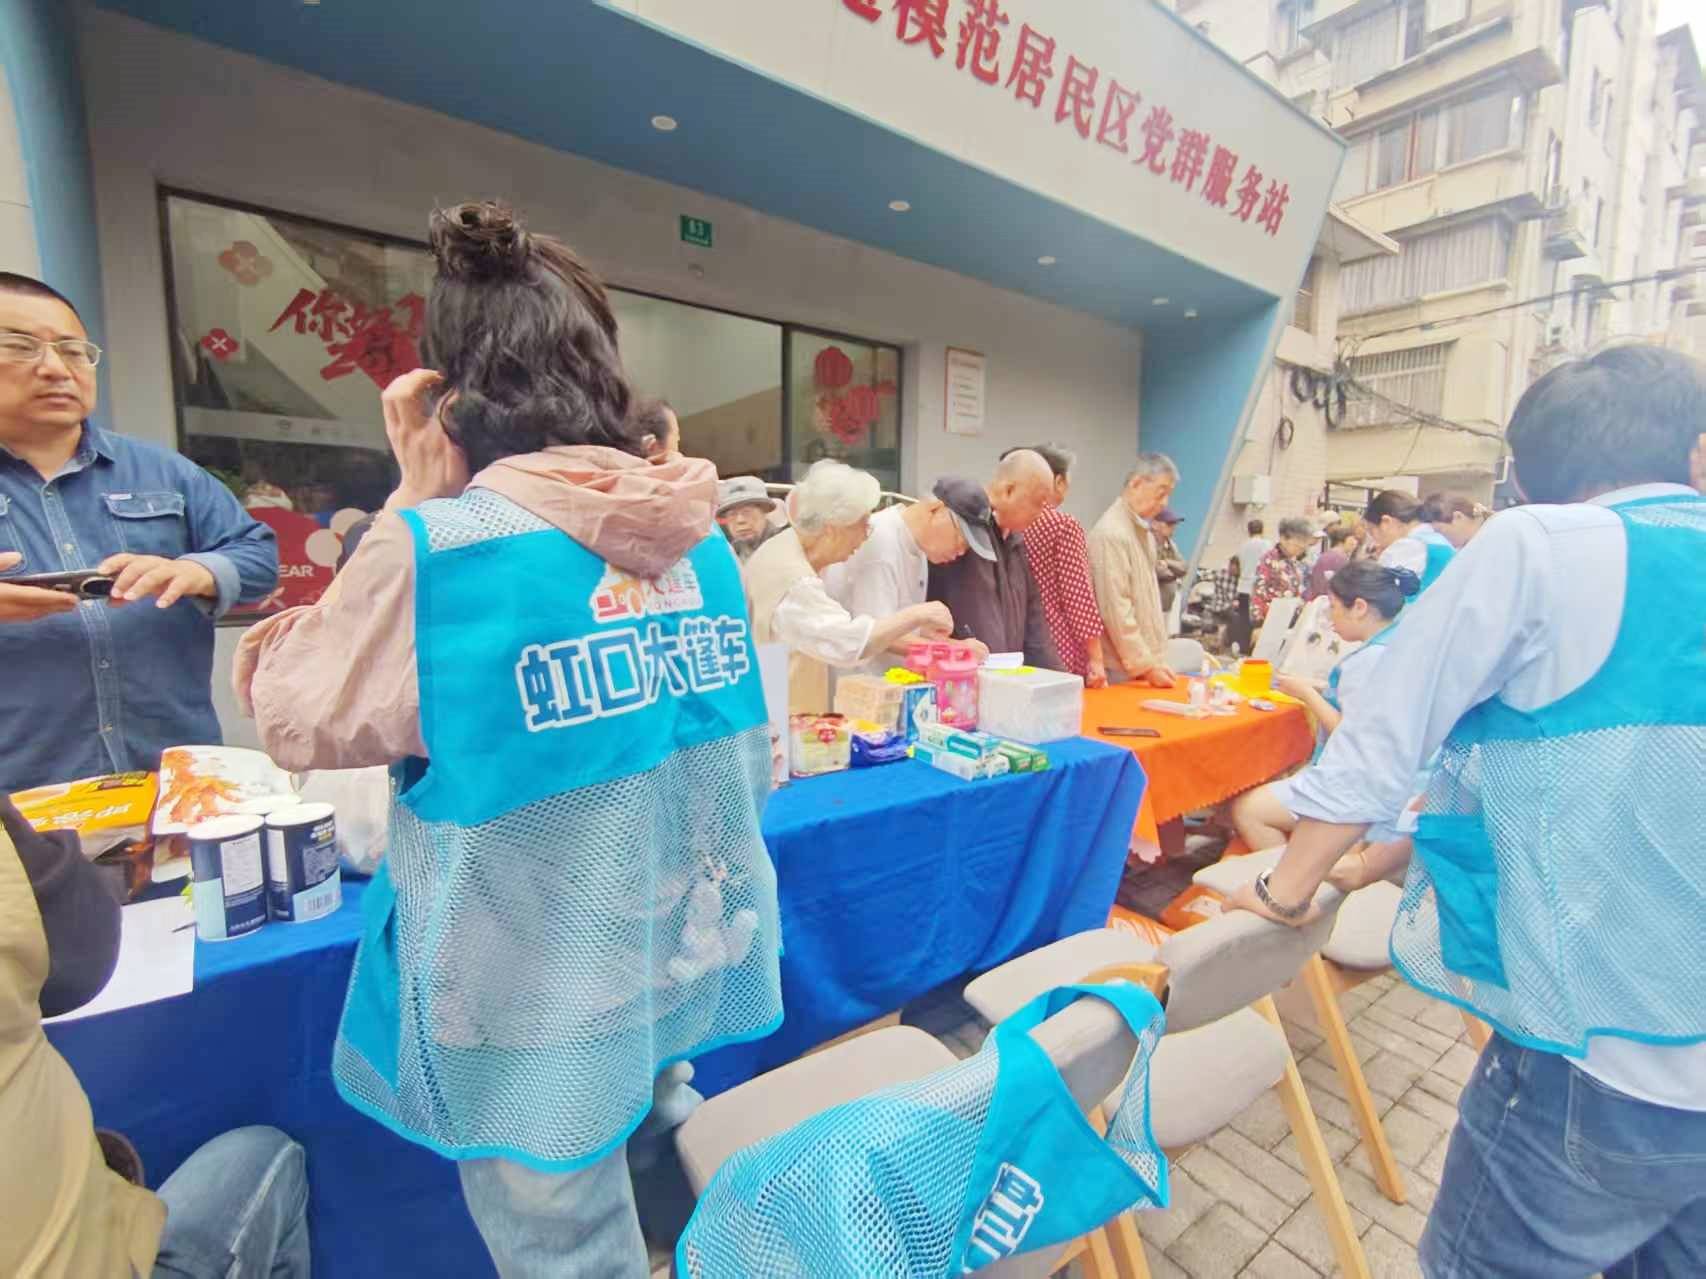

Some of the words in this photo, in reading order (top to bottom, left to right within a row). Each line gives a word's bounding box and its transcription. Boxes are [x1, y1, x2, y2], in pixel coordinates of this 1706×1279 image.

[842, 0, 1290, 237] 模范居民区党群服务站
[278, 564, 315, 578] EAR
[515, 615, 749, 732] 虹口大篷车
